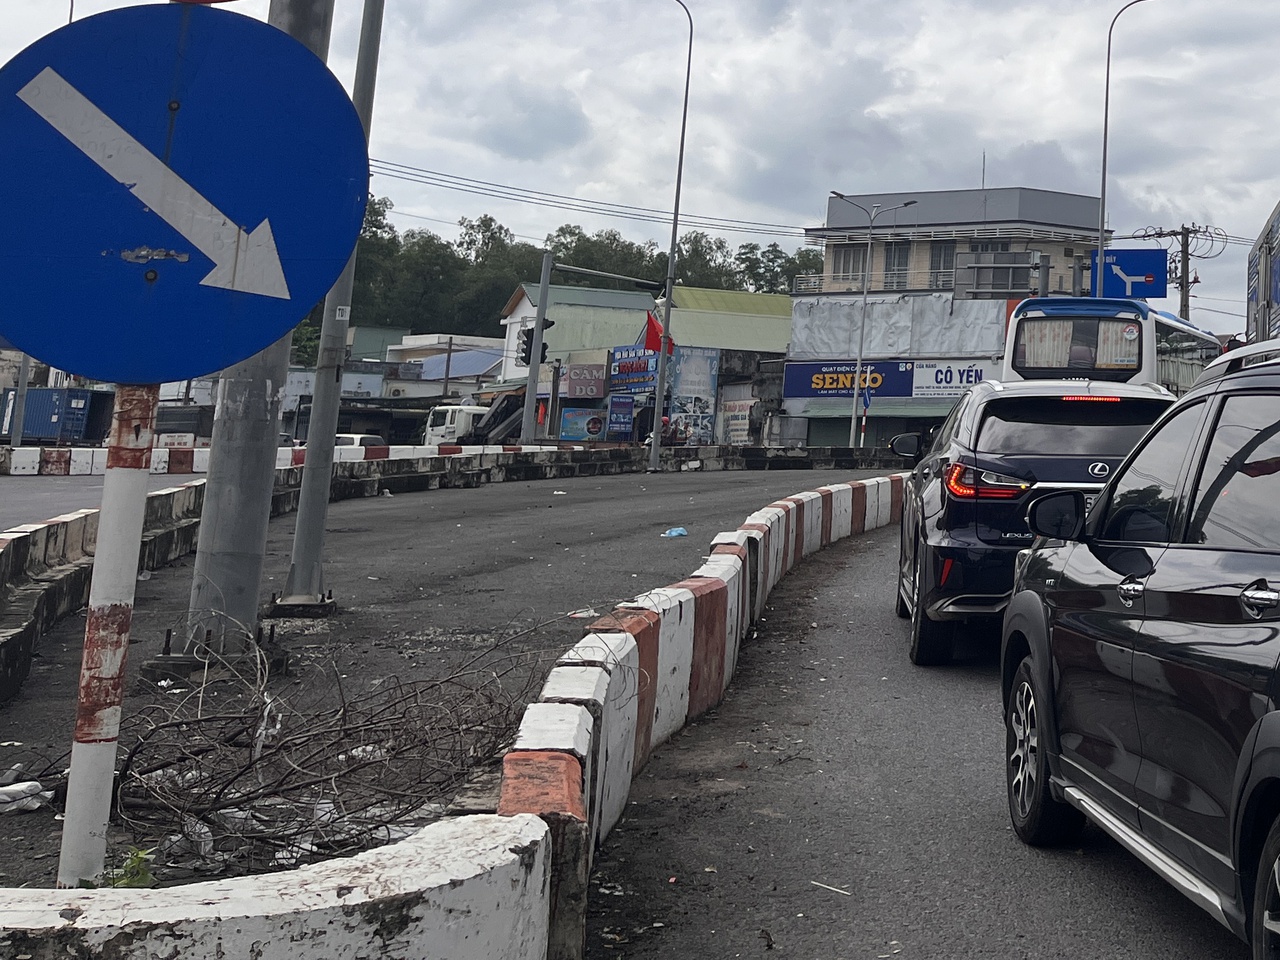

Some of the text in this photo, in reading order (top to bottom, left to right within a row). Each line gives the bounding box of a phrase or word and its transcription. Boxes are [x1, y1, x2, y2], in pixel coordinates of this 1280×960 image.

[811, 373, 883, 389] SENKO
[935, 363, 983, 384] CÔ YẾN
